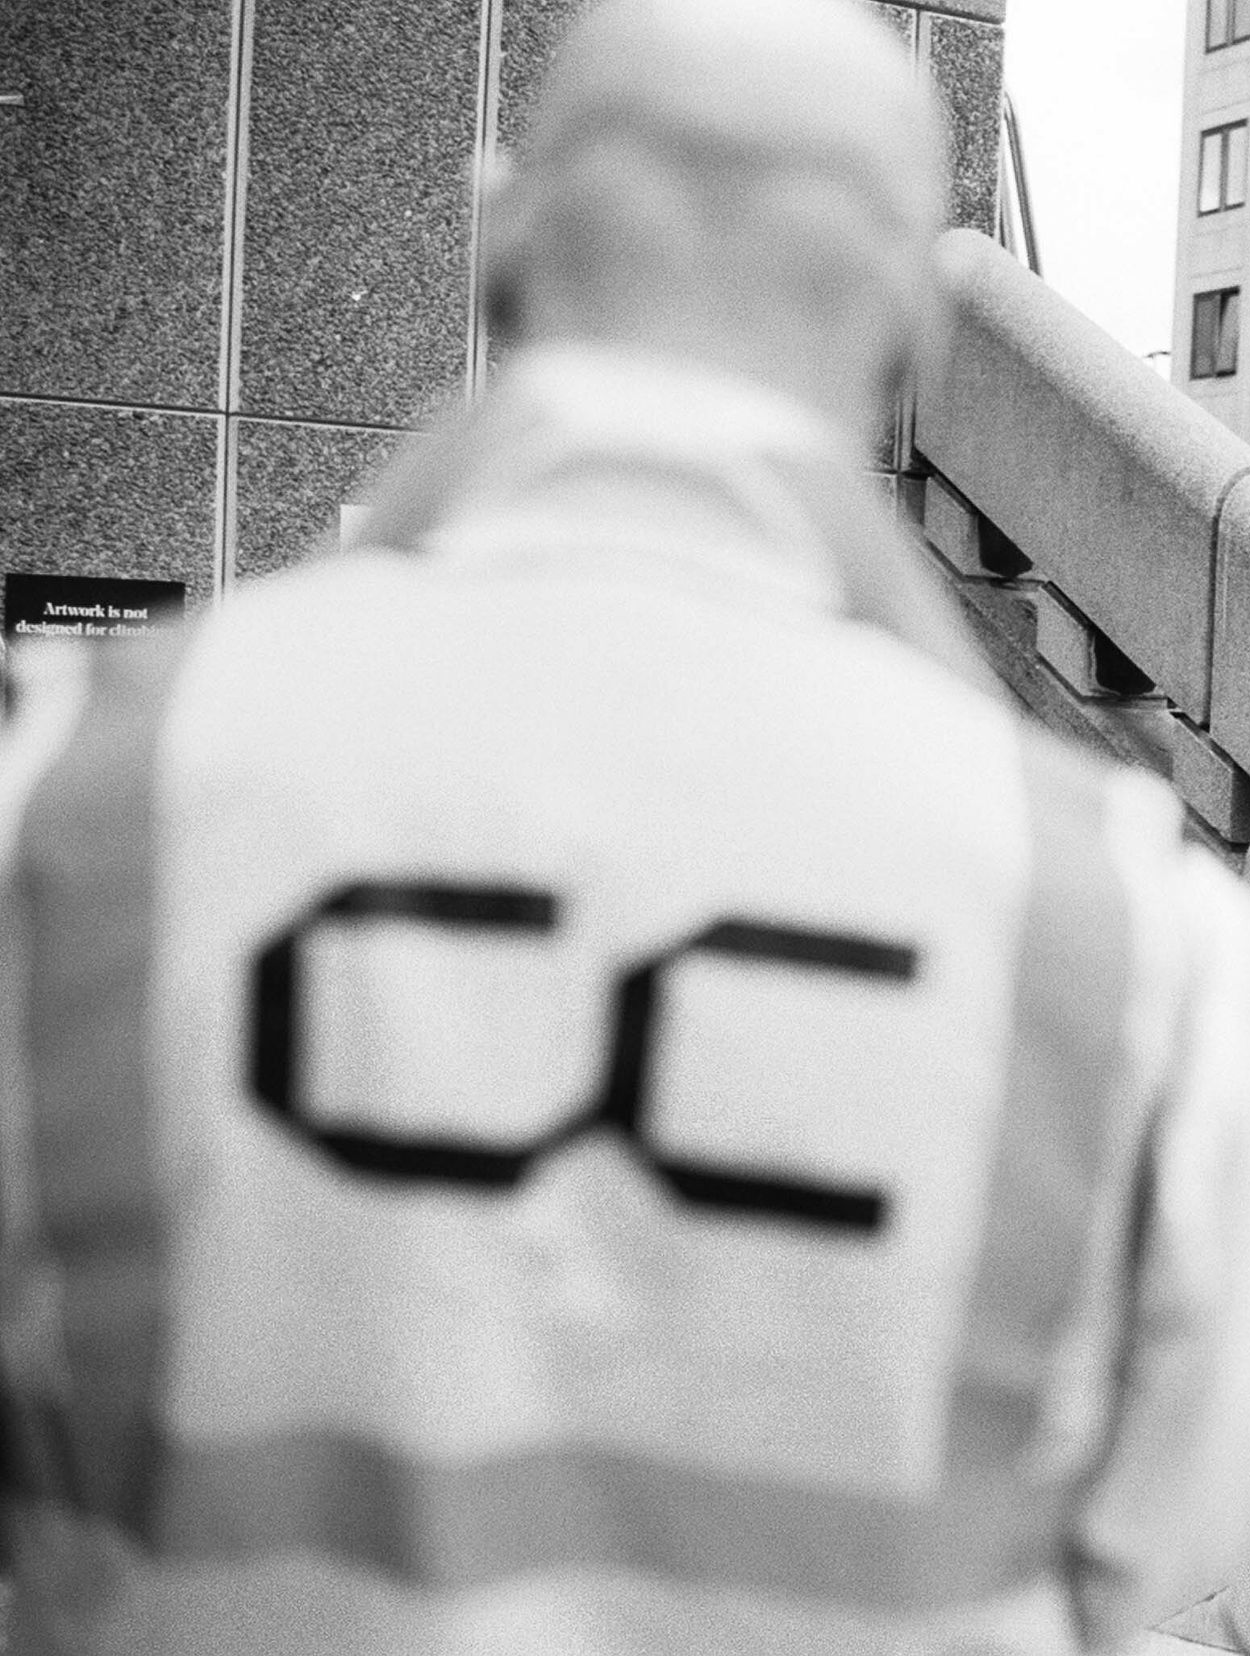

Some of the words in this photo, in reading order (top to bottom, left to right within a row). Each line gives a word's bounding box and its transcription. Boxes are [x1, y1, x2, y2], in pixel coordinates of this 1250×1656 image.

[43, 602, 105, 618] Artwork
[108, 605, 120, 618] is
[123, 608, 148, 619] not
[15, 619, 82, 638] designed
[85, 622, 107, 636] for
